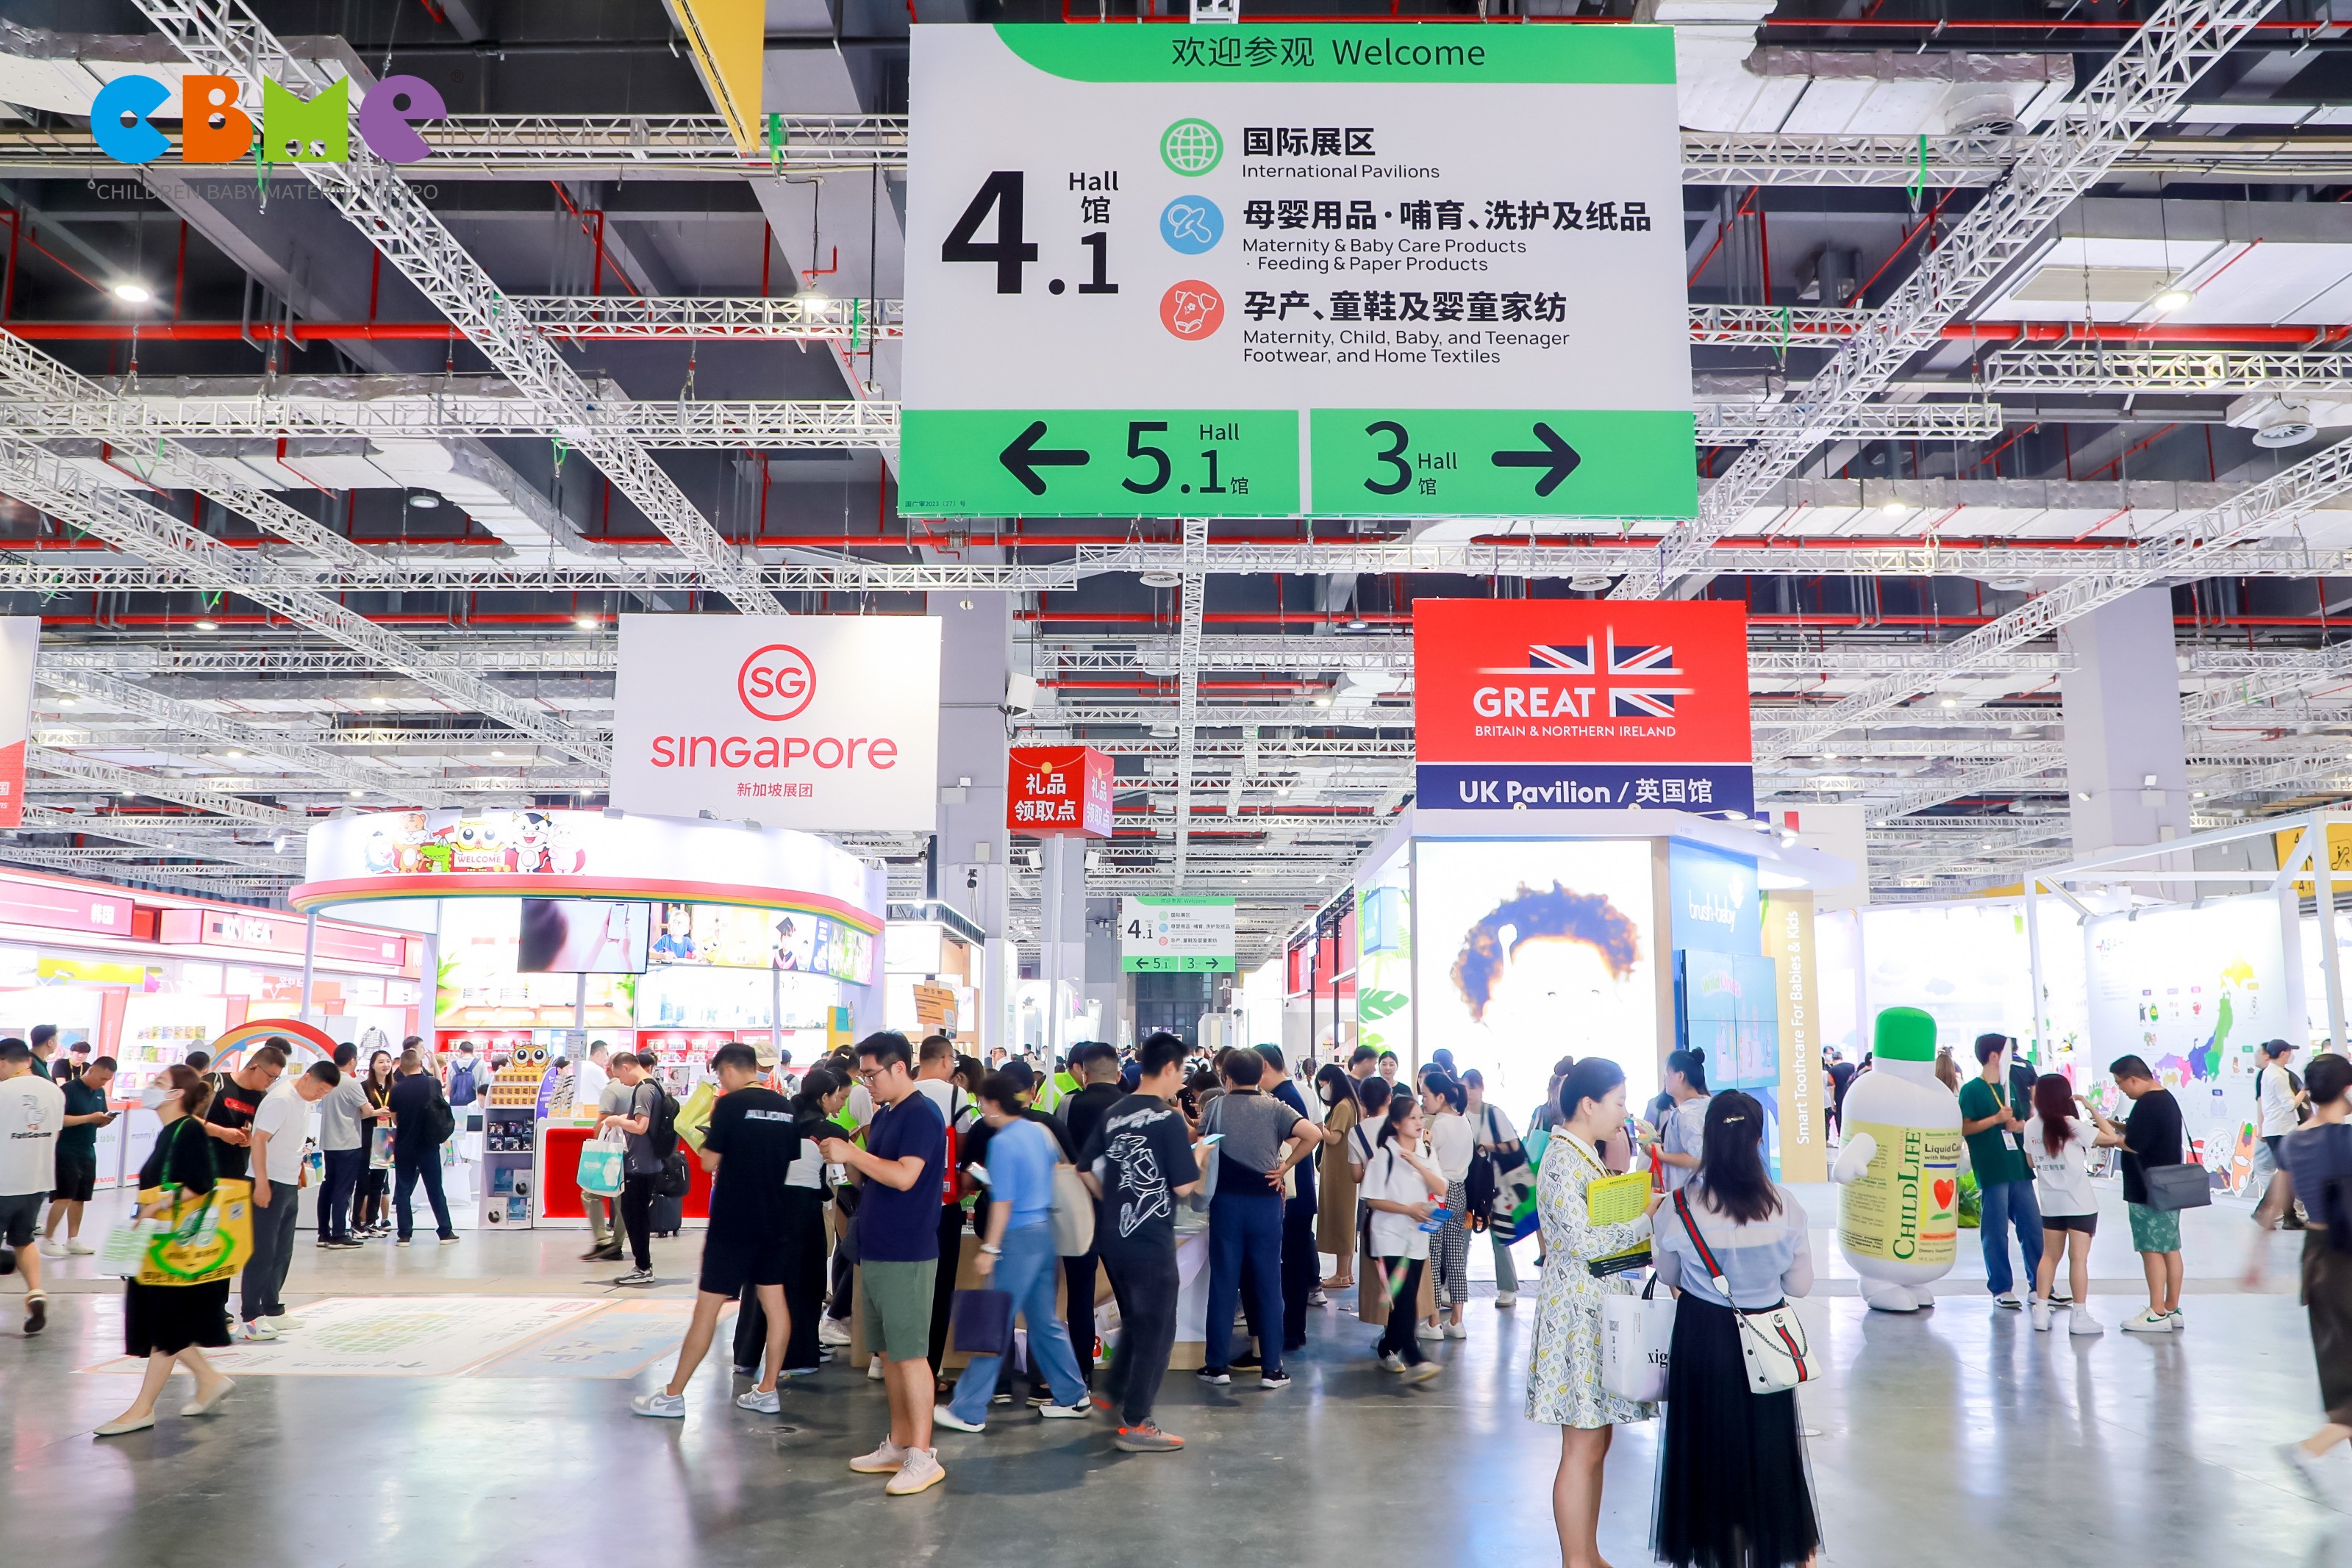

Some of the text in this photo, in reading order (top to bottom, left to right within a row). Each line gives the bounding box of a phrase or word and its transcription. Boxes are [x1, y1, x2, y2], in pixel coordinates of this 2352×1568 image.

[1171, 36, 1485, 68] 欢迎参观 Welcome
[1244, 127, 1376, 157] 国际展区
[1069, 171, 1119, 191] Hall
[1243, 164, 1440, 178] International Pavilions
[1081, 196, 1110, 223] 馆
[942, 171, 1118, 295] 4.1
[1243, 238, 1526, 256] Maternity & Baby Care Products
[1258, 257, 1488, 274] Feeding & Paper Products
[1244, 291, 1567, 322] 孕产、童鞋及婴童家纺
[1244, 329, 1570, 348] Maternity, Child, Baby, and Teenager
[1244, 349, 1501, 365] Footwear, and Home Textiles
[1200, 423, 1240, 441] Hall
[1121, 421, 1226, 494] 5.1
[1363, 420, 1457, 495] 3 Hall
[1230, 476, 1249, 495] 馆
[1418, 477, 1437, 495] 馆
[749, 667, 806, 698] SG
[1473, 687, 1595, 717] GREAT
[1475, 725, 1676, 737] BRITAIN & NORTHERN IRELAND
[736, 782, 813, 798] 新加坡展团
[1026, 773, 1066, 795] 礼品
[1091, 776, 1107, 803] 礼品
[1459, 780, 1500, 803] UK
[1507, 780, 1611, 803] Pavilion
[1635, 778, 1713, 803] 英国馆
[1014, 799, 1076, 822] 领取点
[1086, 801, 1110, 829] 领取点
[1688, 889, 1736, 933] brush-baby
[1127, 919, 1154, 939] 4.1
[1153, 958, 1168, 969] 5.1
[1187, 958, 1195, 969] 3
[1786, 911, 1809, 1144] Smart Toothcare For Babies & Kids
[1925, 1144, 1951, 1154] Liquid
